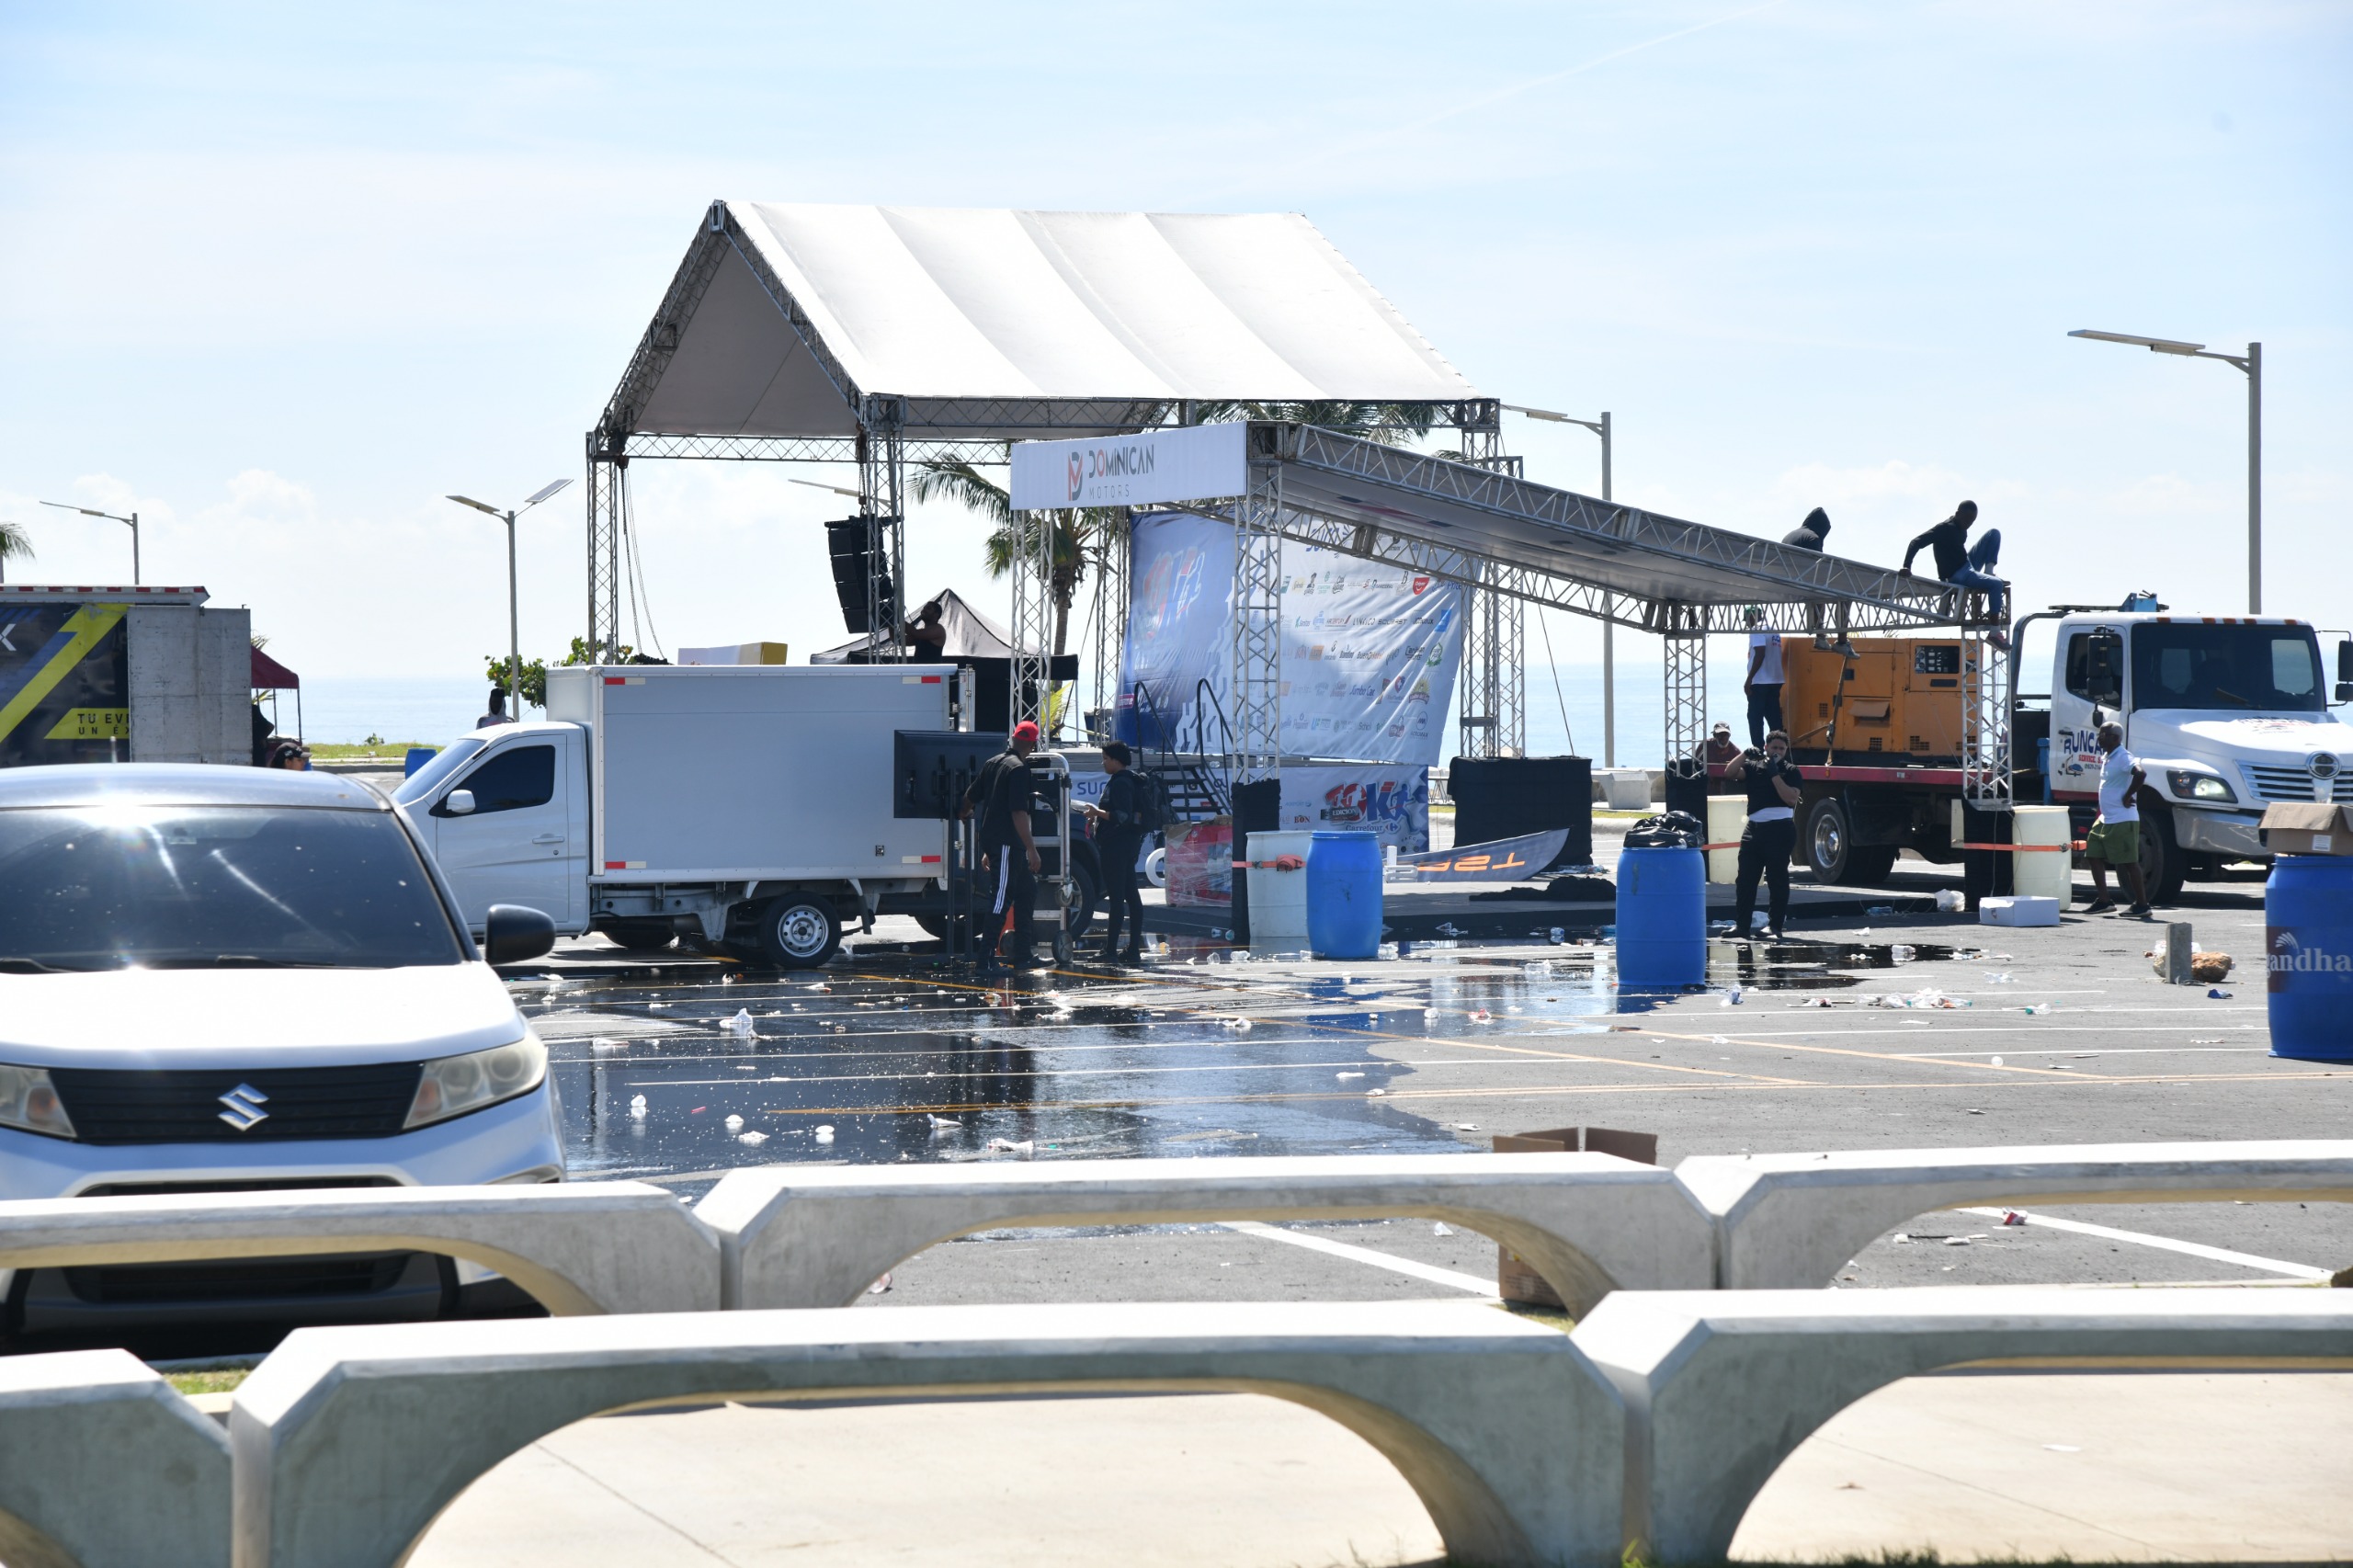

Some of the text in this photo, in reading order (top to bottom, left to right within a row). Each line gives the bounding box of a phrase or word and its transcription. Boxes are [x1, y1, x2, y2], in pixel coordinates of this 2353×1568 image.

[1088, 444, 1154, 478] DOMINICAN
[1089, 484, 1130, 499] MOTORS
[78, 713, 96, 724] TU
[79, 727, 97, 735] UN
[2064, 730, 2106, 756] RUNCA
[1346, 824, 1383, 832] Carrefour
